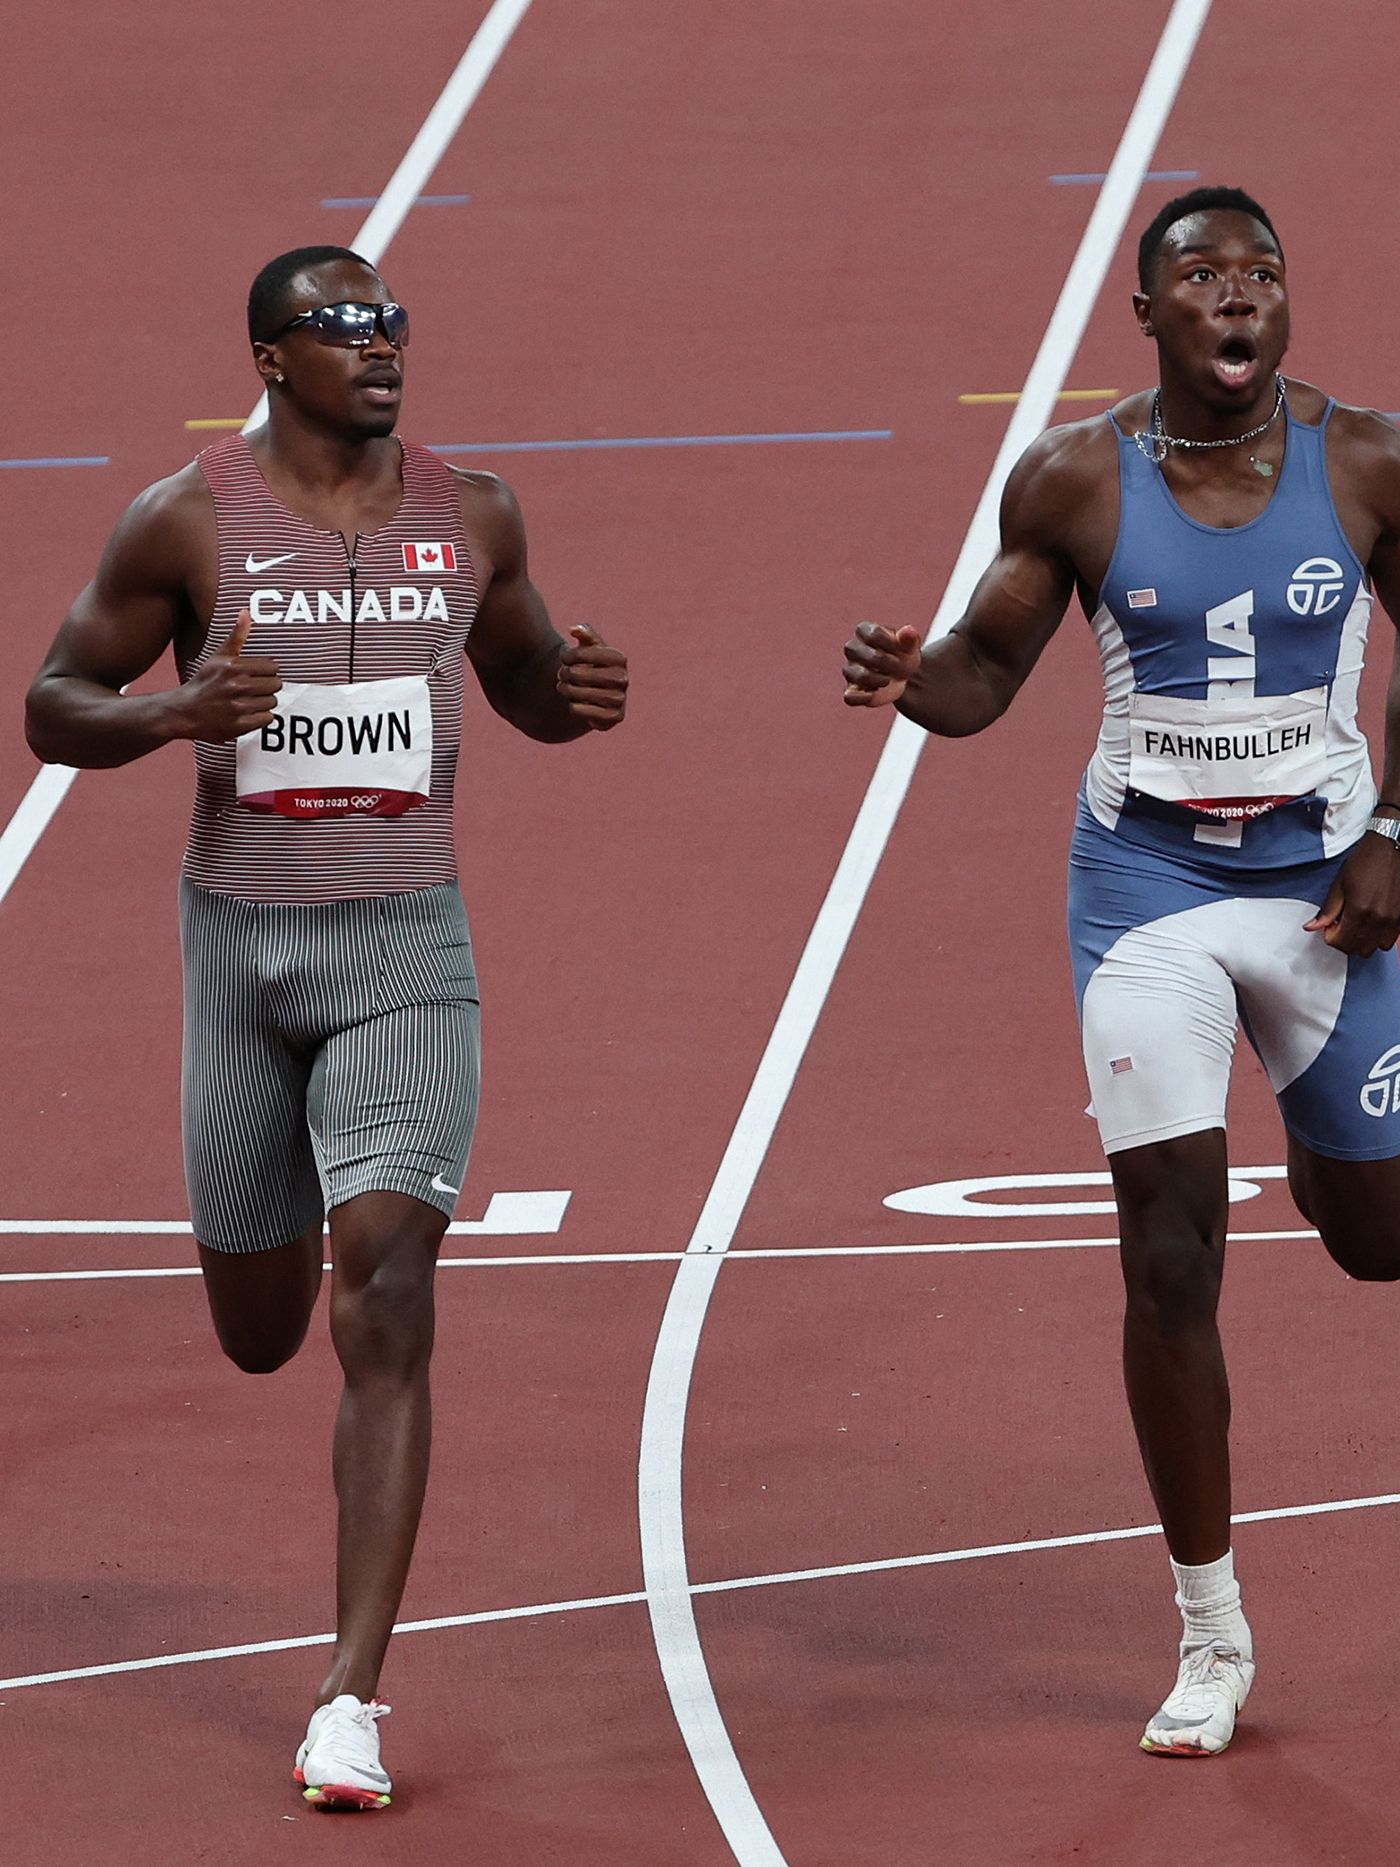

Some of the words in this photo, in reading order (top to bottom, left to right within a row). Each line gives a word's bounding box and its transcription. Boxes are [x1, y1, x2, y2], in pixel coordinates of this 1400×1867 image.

[249, 586, 450, 624] CANADA
[260, 709, 412, 756] BROWN
[1144, 723, 1312, 762] FAHNBULLEH
[294, 798, 325, 809] TOKYO
[325, 798, 349, 808] 2020
[1220, 807, 1244, 820] 2020
